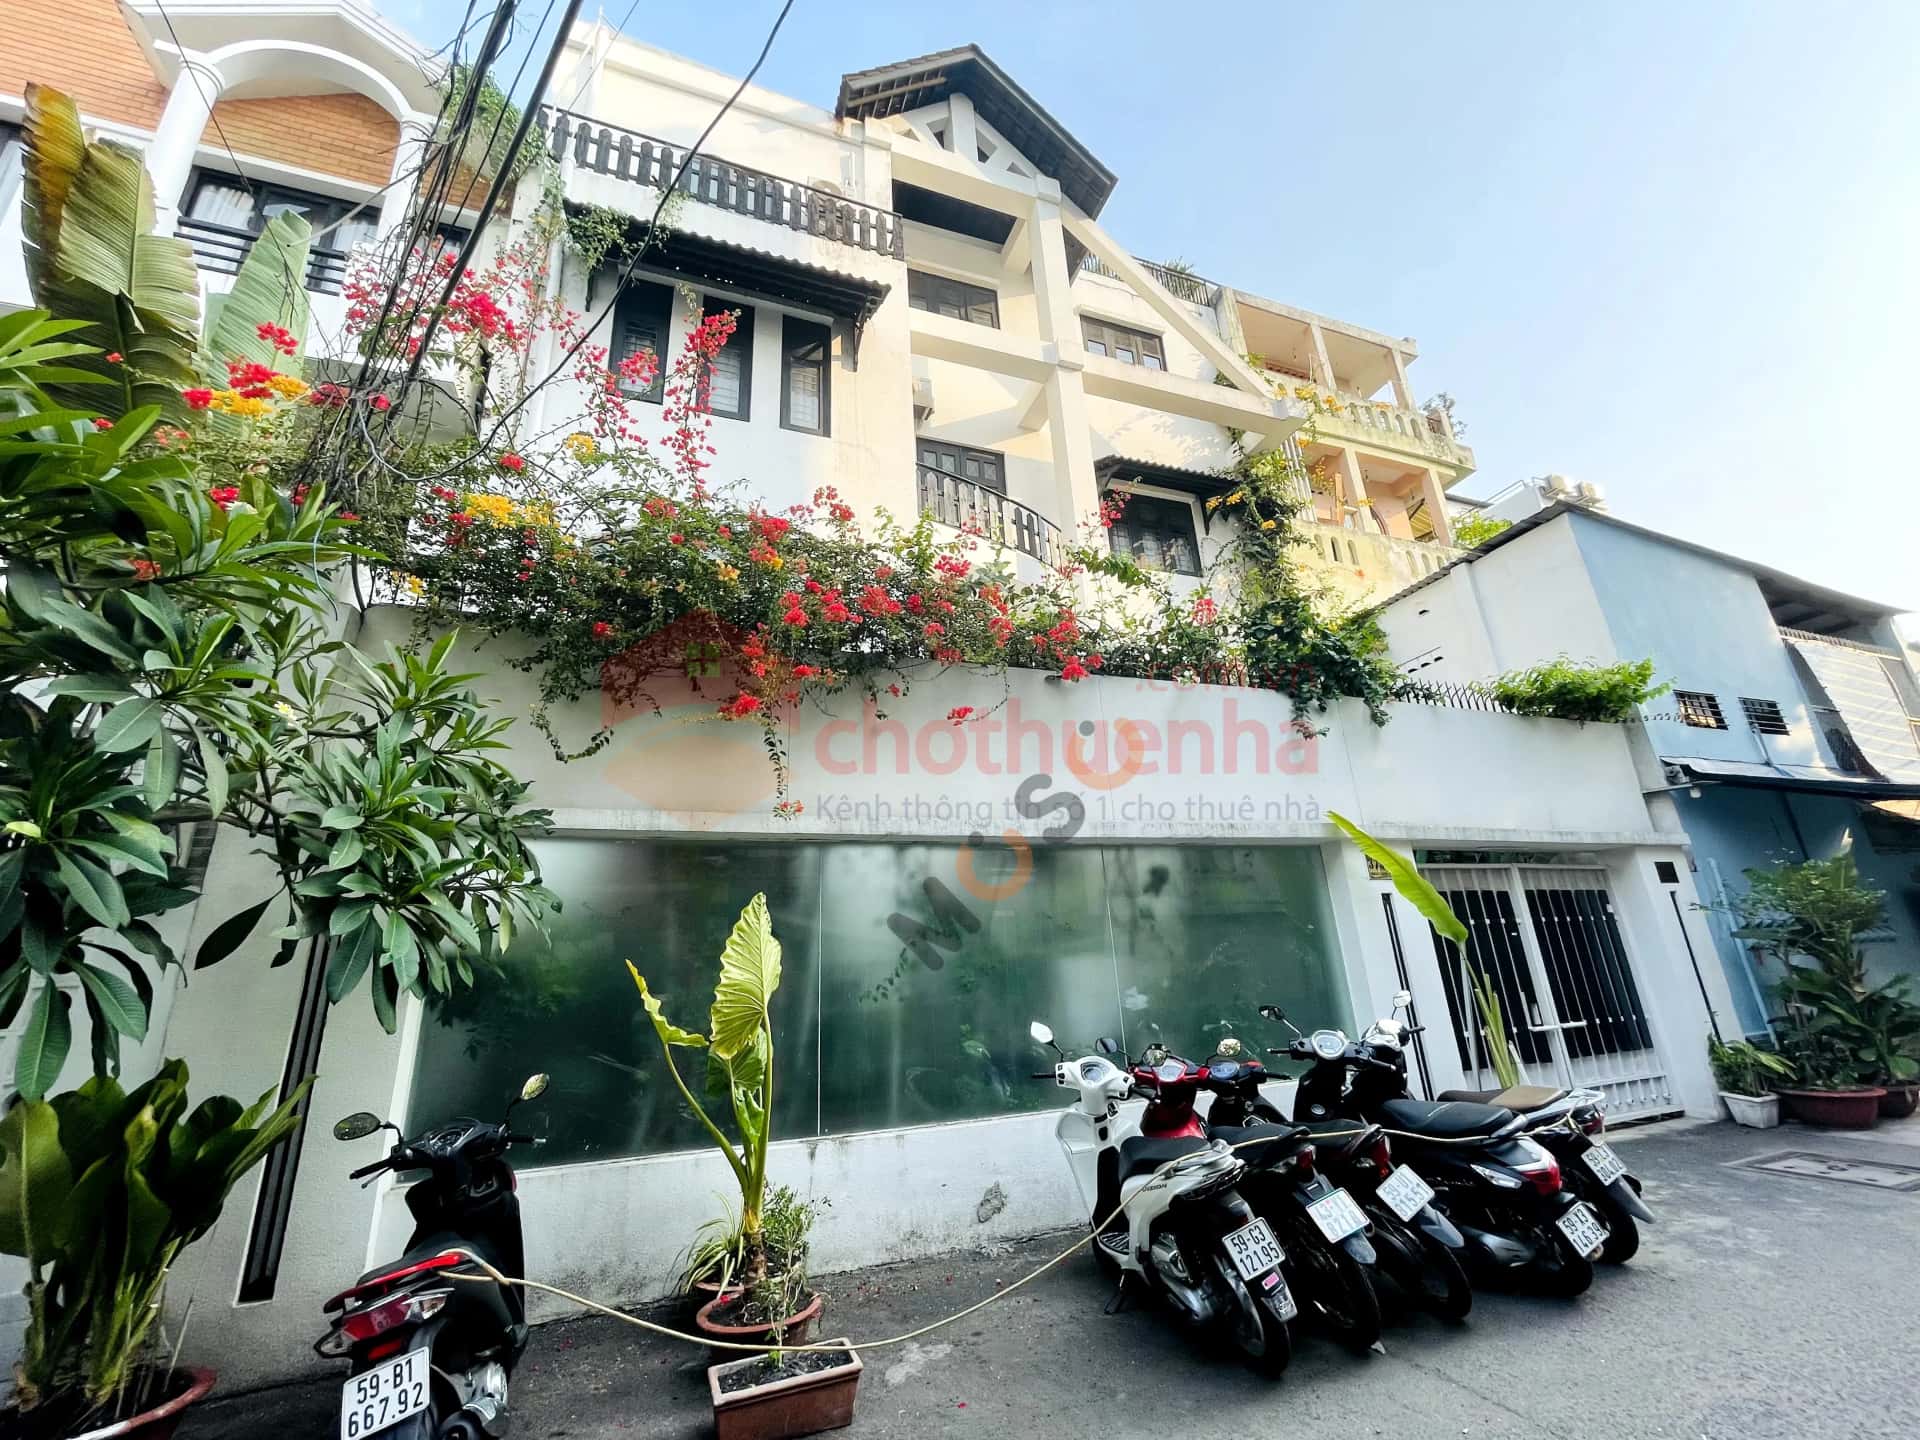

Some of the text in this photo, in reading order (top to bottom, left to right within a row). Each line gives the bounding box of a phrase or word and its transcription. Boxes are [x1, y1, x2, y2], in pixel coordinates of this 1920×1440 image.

[1230, 1224, 1266, 1255] 59-G3
[1239, 1241, 1280, 1275] 121.95
[356, 1357, 413, 1405] 59-B1
[347, 1381, 424, 1438] 667.92
